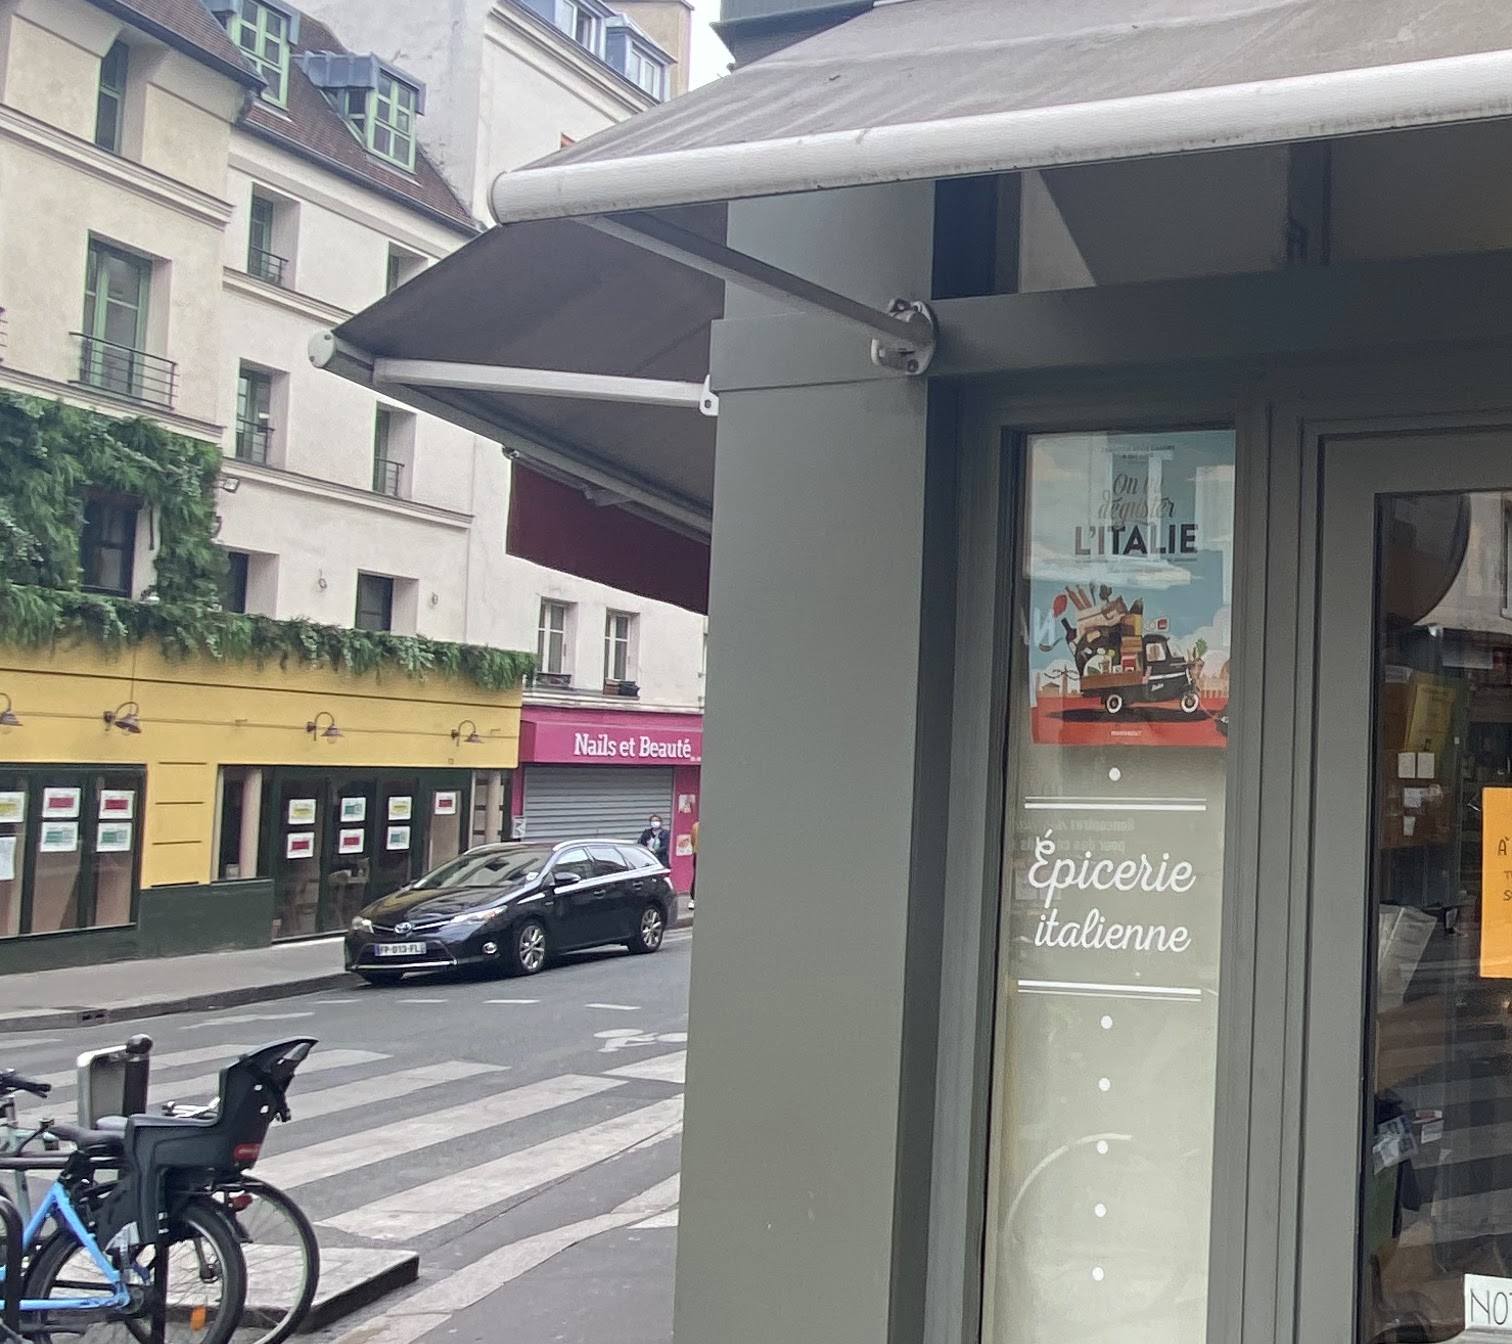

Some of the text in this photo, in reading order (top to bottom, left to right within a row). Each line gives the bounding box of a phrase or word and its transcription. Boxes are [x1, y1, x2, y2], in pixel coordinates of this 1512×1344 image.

[1113, 473, 1138, 495] On
[574, 732, 691, 758] Nails et Beauté
[1028, 829, 1196, 908] Épicerie
[1035, 908, 1191, 953] italienne
